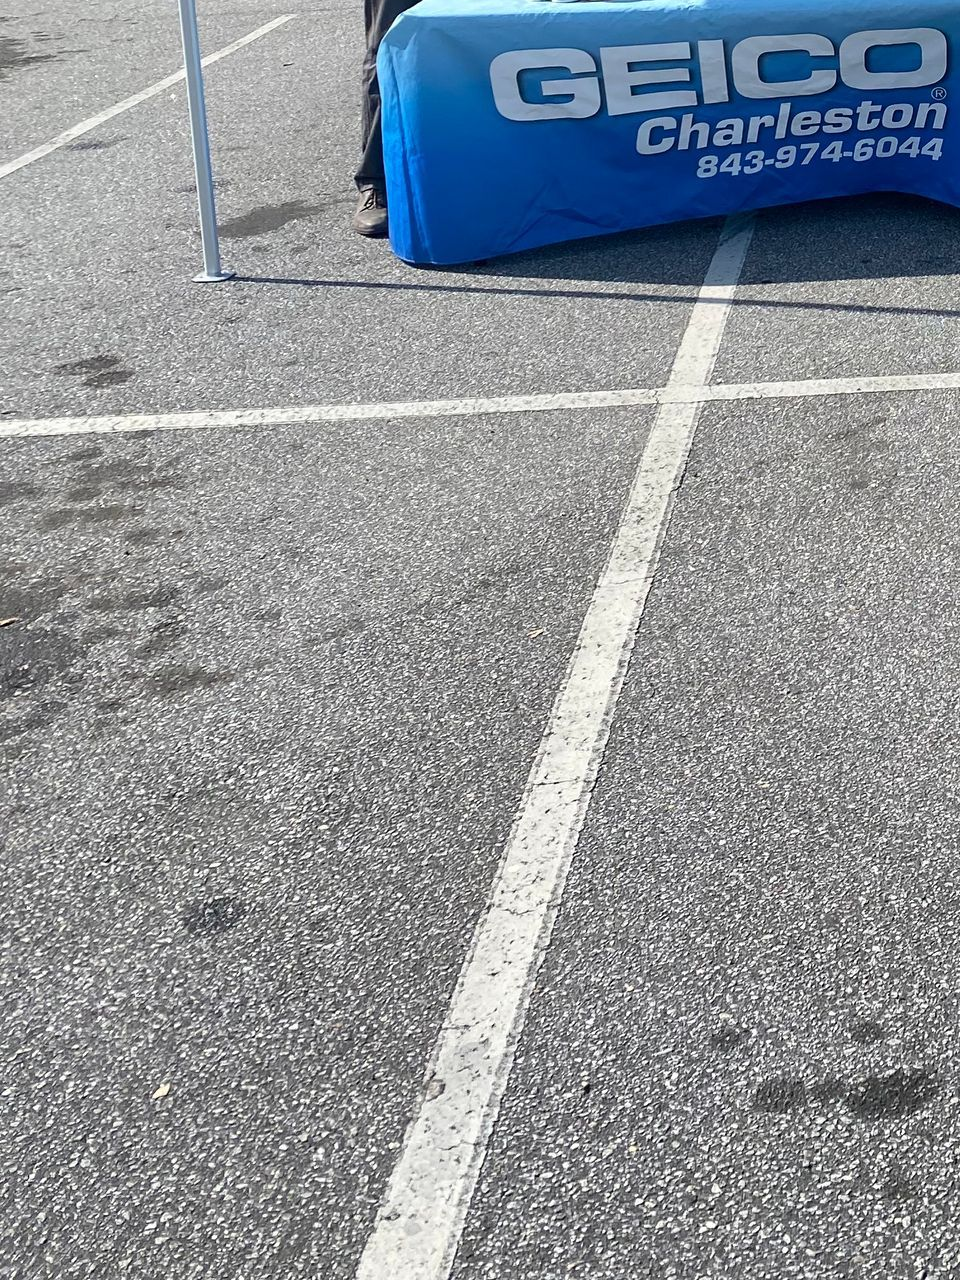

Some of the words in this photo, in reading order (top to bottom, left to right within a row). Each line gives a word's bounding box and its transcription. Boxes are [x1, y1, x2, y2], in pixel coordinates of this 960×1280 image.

[489, 27, 948, 122] GEICO
[636, 100, 947, 155] Charleston
[696, 136, 943, 180] 843-974-6044
